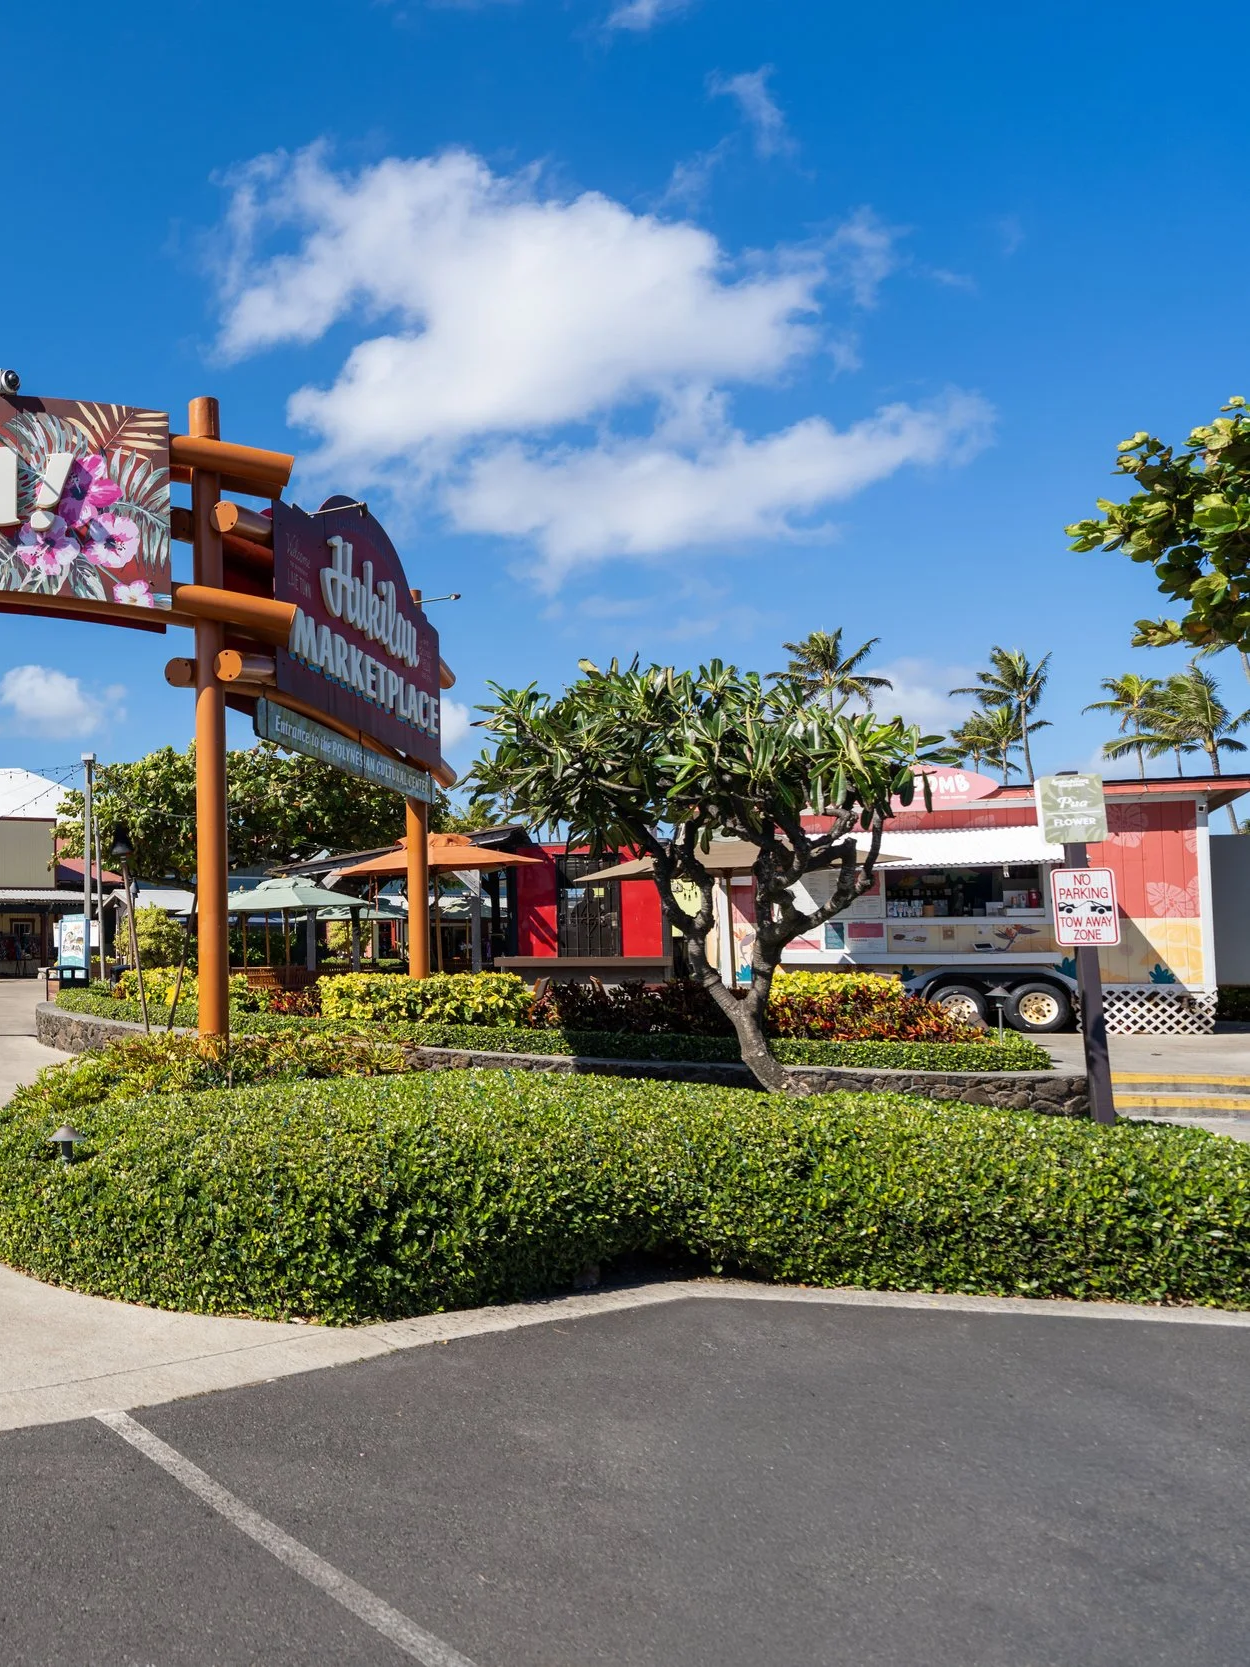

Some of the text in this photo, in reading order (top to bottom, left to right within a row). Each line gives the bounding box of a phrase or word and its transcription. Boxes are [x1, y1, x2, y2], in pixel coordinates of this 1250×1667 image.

[320, 535, 420, 667] Hukilau
[289, 607, 439, 735] MARKETPLACE
[275, 715, 429, 794] Entrance to the POLYNESIAN CULTURAL CENTER
[1057, 796, 1088, 809] Pua
[1054, 817, 1096, 827] FLOWER
[1073, 873, 1091, 886] NO
[1059, 886, 1109, 899] PARKING
[1059, 916, 1112, 927] TOW AWAY
[1073, 929, 1102, 940] ZONE
